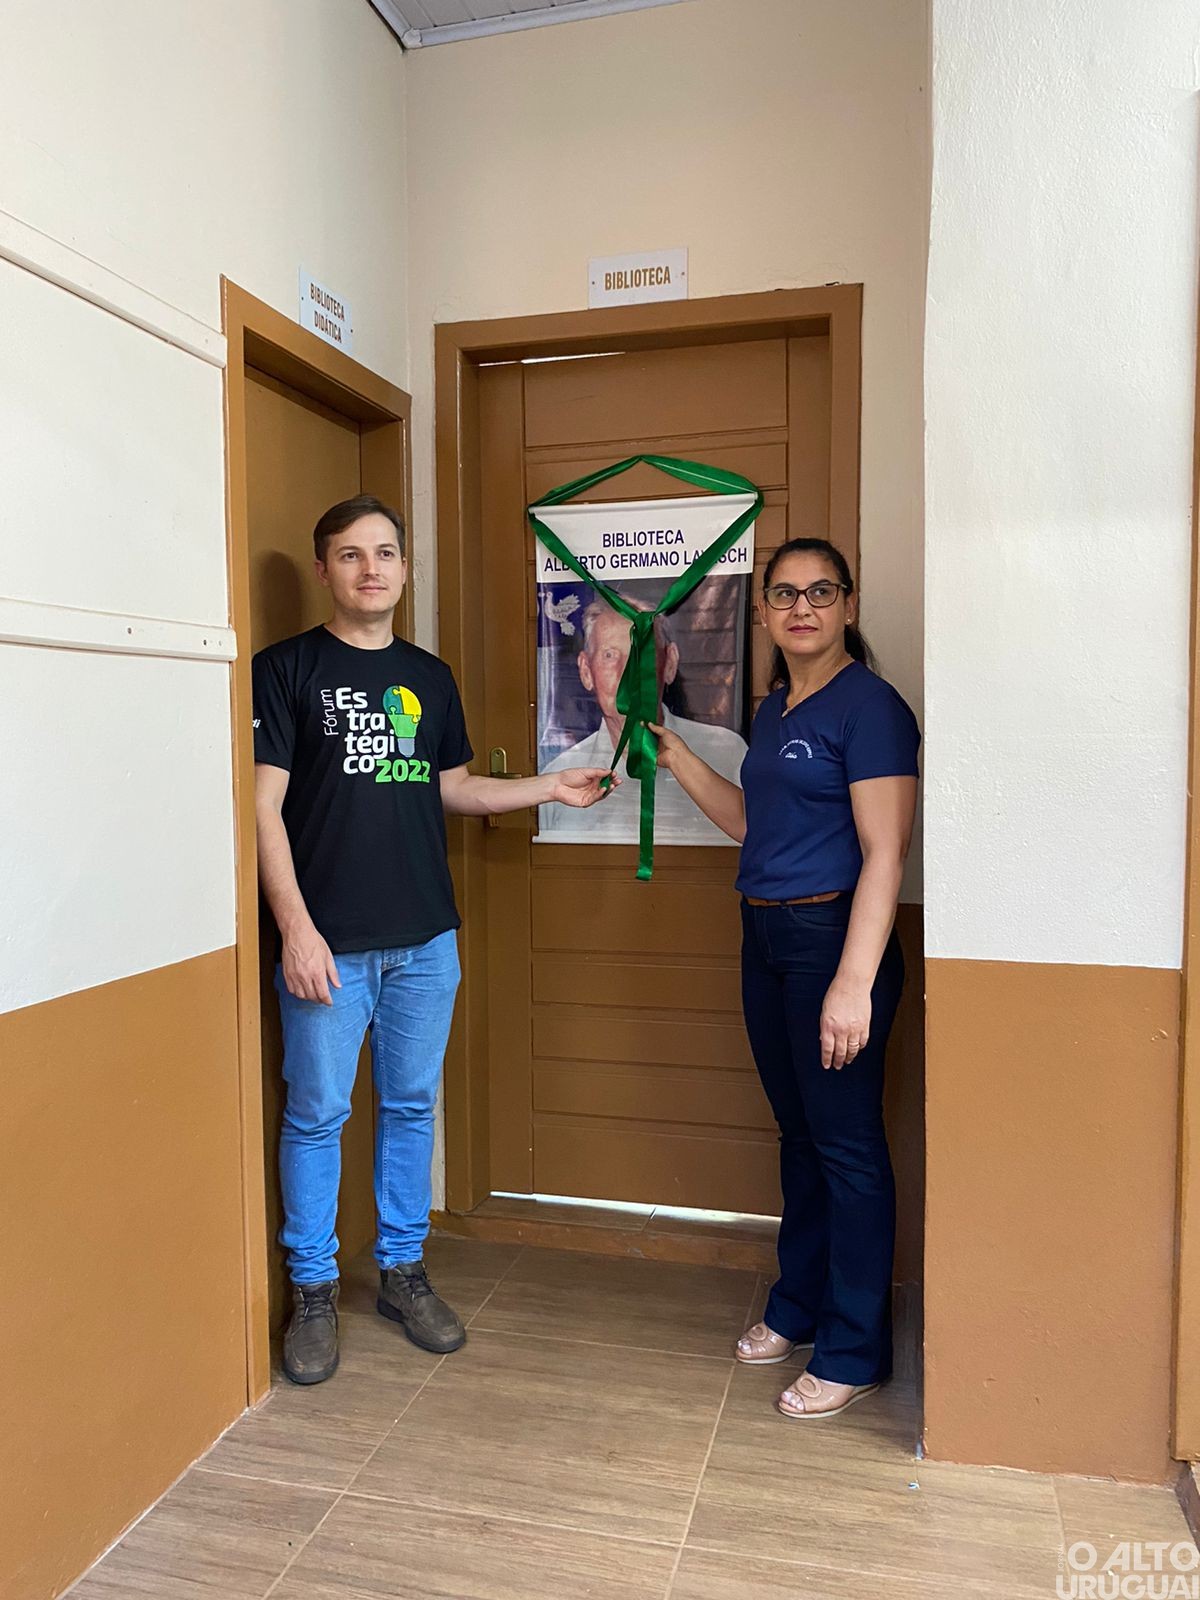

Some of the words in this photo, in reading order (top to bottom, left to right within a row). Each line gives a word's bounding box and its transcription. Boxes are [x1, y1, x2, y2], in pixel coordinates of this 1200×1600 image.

[604, 265, 671, 291] BIBLIOTECA
[310, 282, 345, 322] BIBLIOTECA
[314, 310, 342, 344] DIDÁTICA
[602, 529, 685, 548] BIBLIOTECA
[543, 554, 606, 572] ALRTO
[610, 550, 680, 569] GERMANO
[684, 547, 747, 565] LASCH
[335, 687, 369, 710] Es
[320, 689, 339, 736] Fórum
[346, 709, 386, 731] tra
[344, 727, 395, 760] tégi
[343, 754, 376, 775] co
[375, 759, 431, 783] 2022
